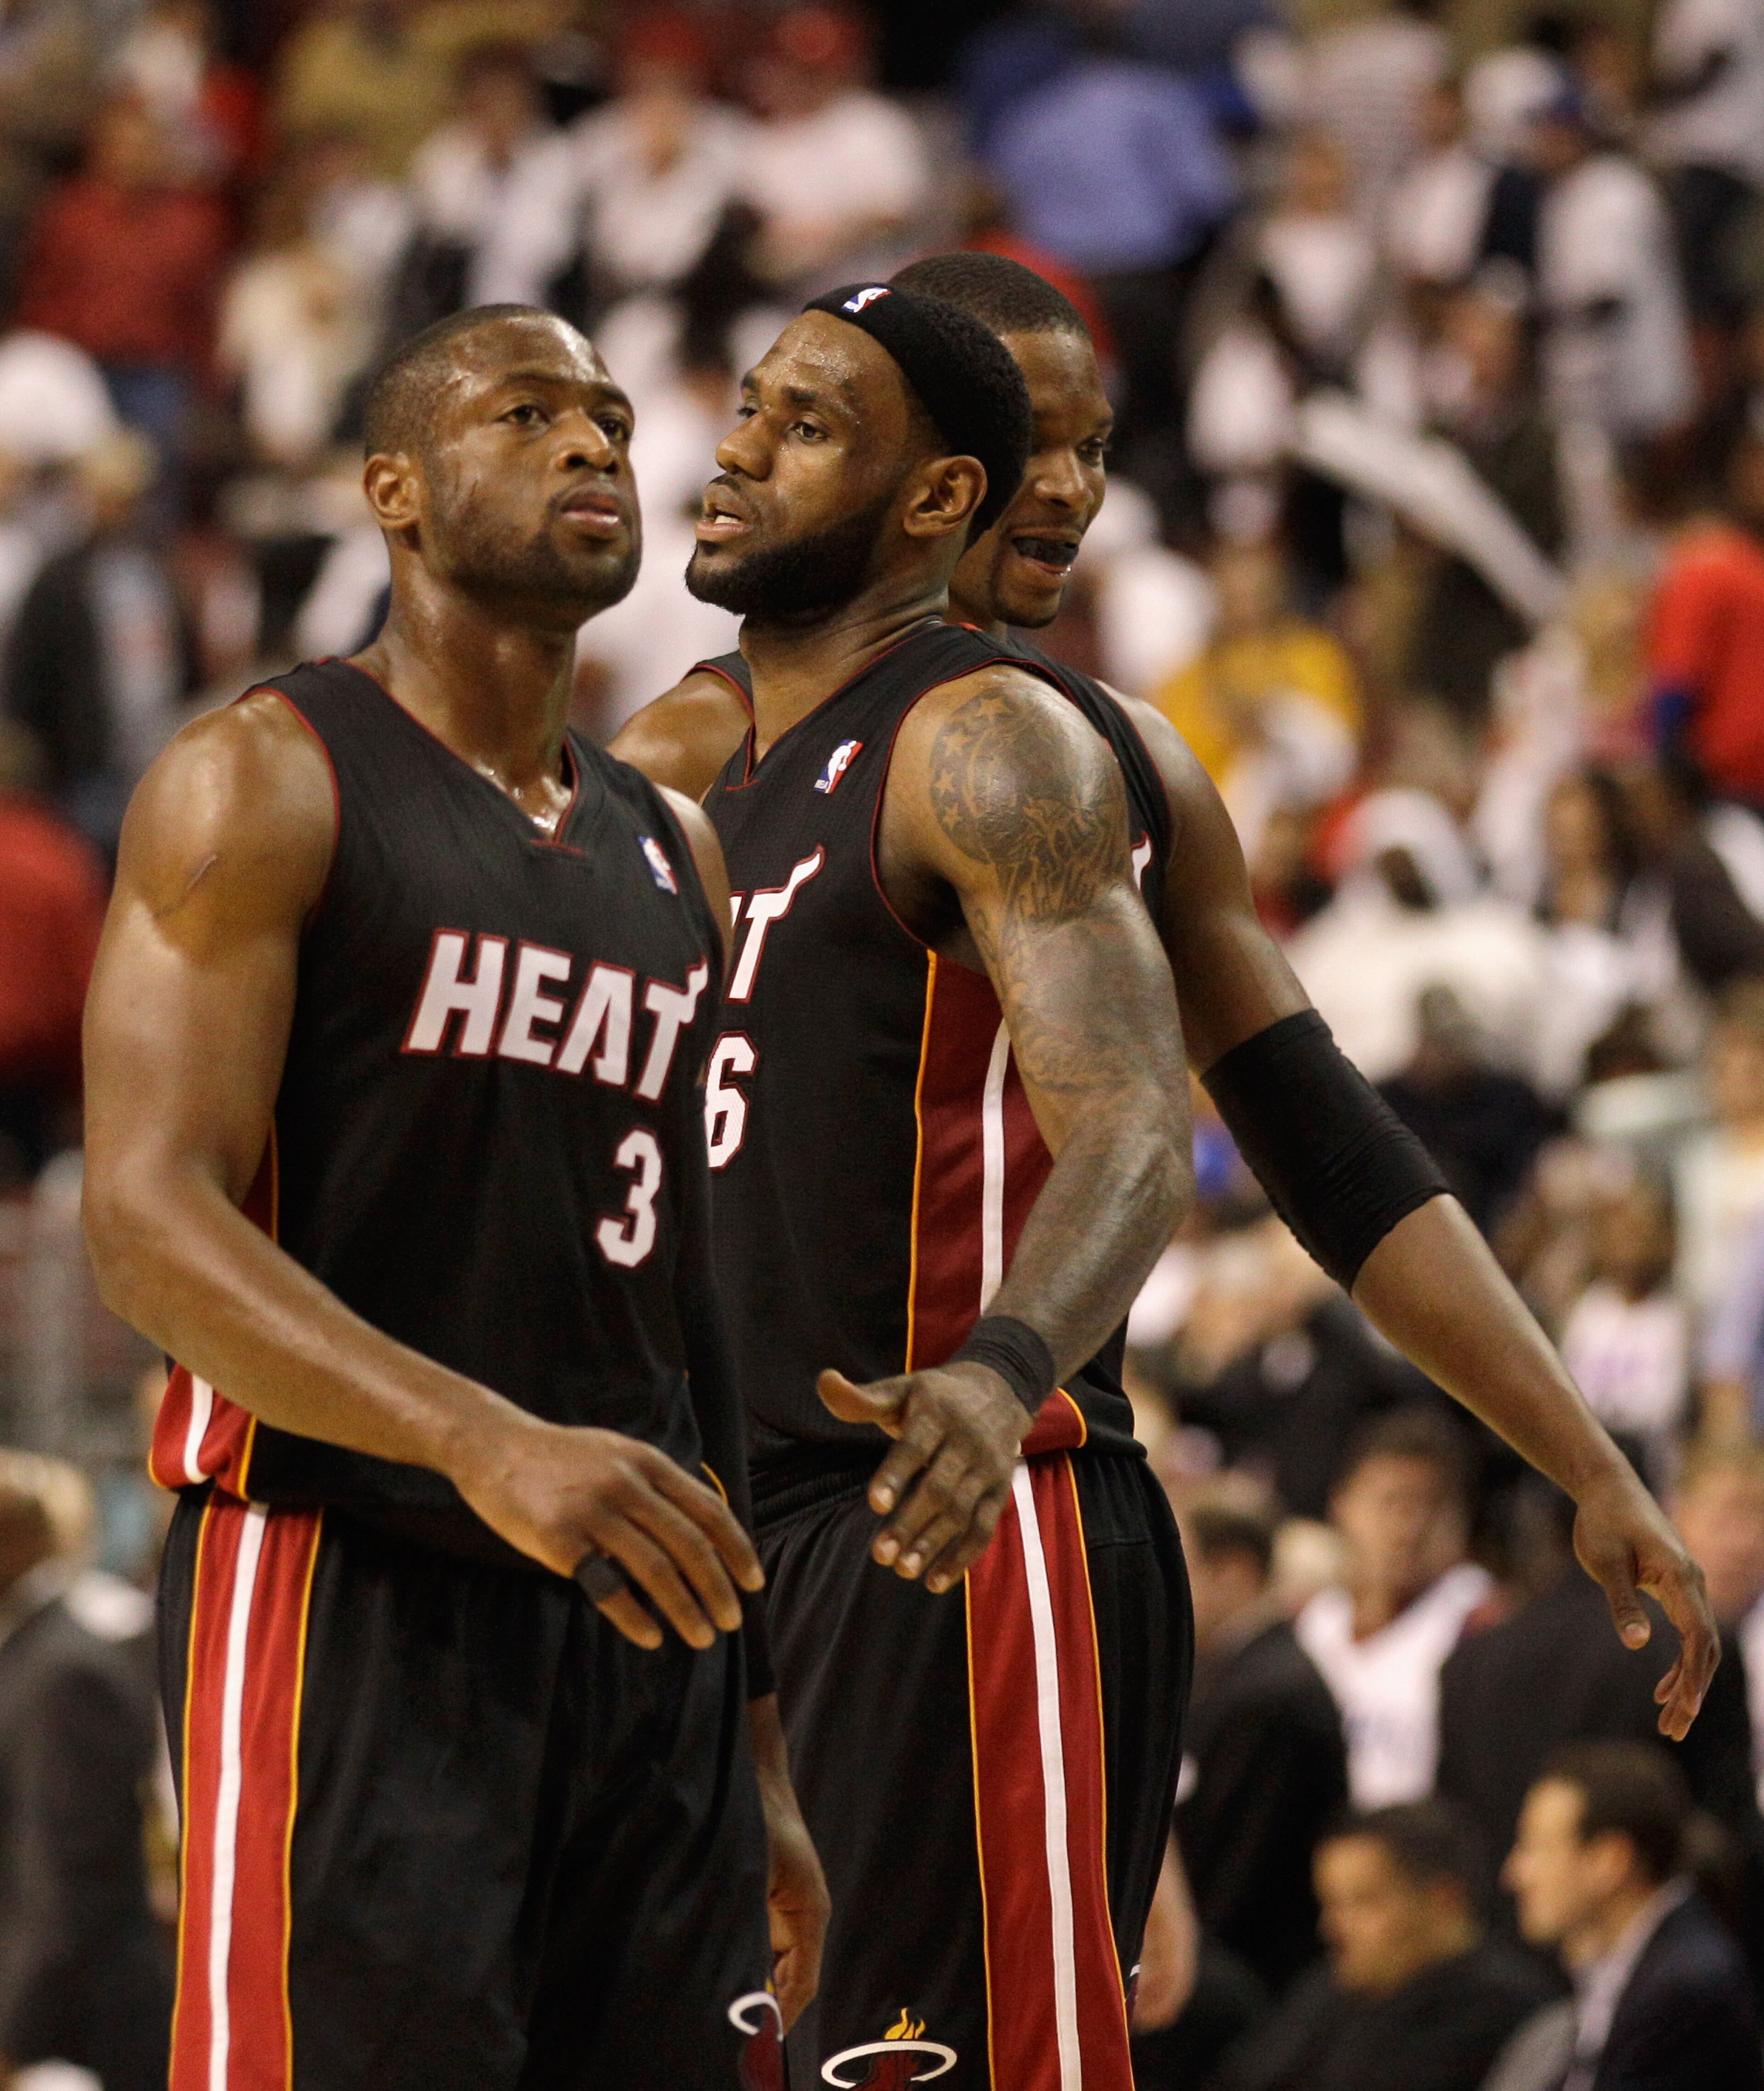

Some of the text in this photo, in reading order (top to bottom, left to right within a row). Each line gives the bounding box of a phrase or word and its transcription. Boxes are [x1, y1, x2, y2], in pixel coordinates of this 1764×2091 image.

[727, 843, 825, 1003] T
[401, 927, 708, 1102] HEAT
[705, 1031, 758, 1170] 6
[594, 1126, 662, 1268] 3
